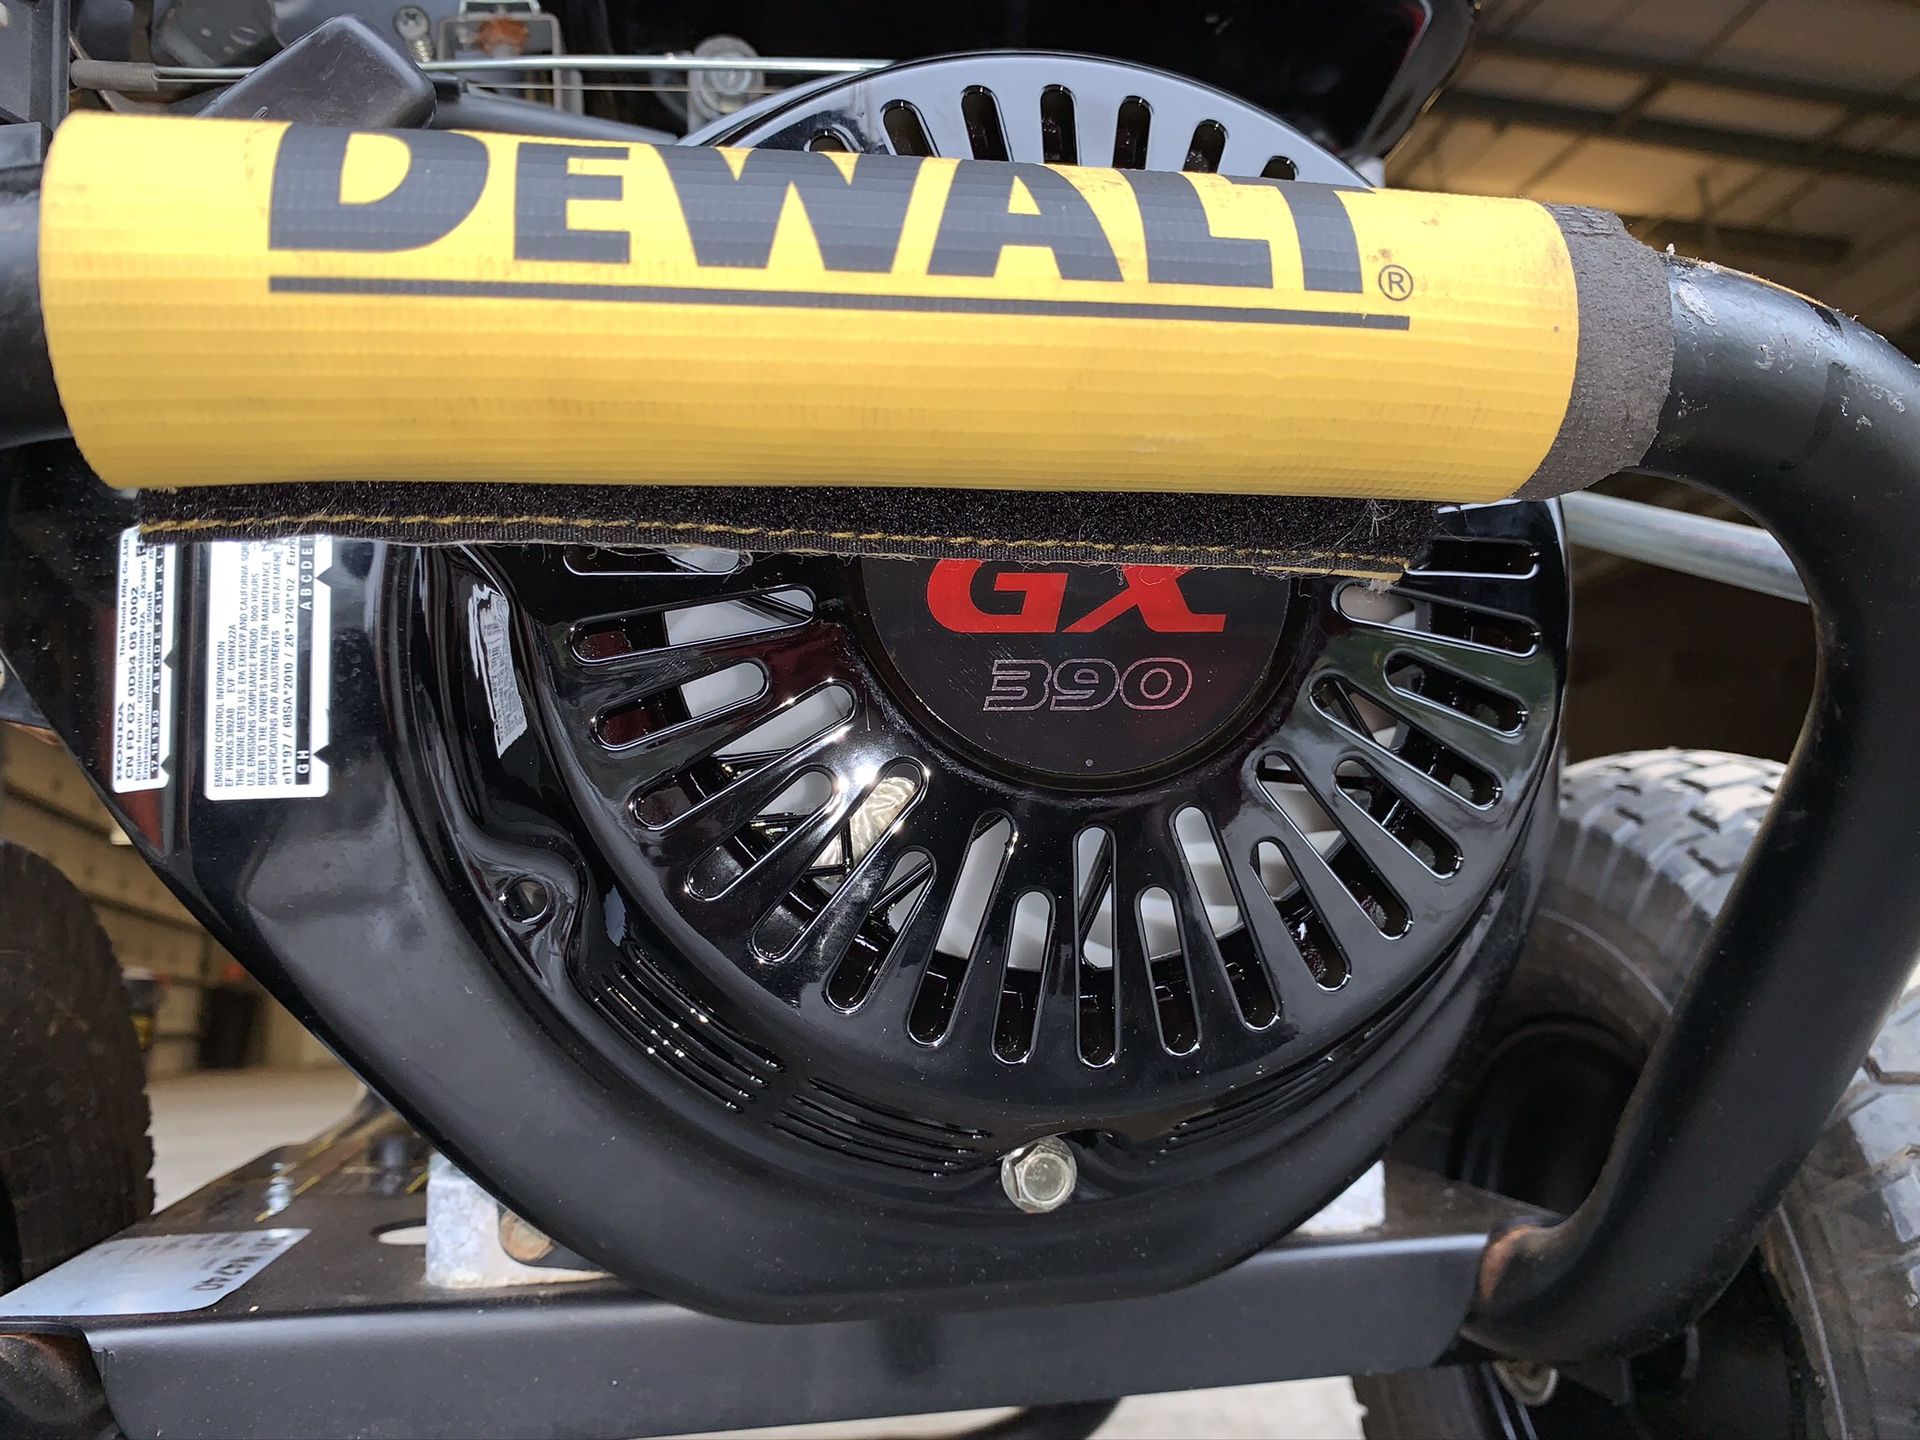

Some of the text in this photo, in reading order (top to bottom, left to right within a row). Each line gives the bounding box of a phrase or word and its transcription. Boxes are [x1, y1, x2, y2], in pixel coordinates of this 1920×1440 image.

[269, 124, 1376, 294] DEWALT
[300, 561, 312, 569] D
[240, 566, 248, 610] CALIFORNIA
[251, 573, 259, 601] HOURS
[927, 557, 1227, 633] GX
[130, 586, 138, 625] 0002
[300, 602, 311, 610] A
[239, 614, 248, 631] AND
[130, 632, 137, 649] 05
[228, 625, 236, 670] CMHNX22A
[250, 629, 258, 658] PERIOD
[258, 562, 270, 785] REFER TO THE OWNER'S MANUAL FOR MAINTENANCE
[271, 630, 279, 693] ADJUSTMENTS
[238, 670, 246, 684] EPA
[248, 662, 257, 716] COMPLIANCE
[982, 657, 1193, 711] 390
[127, 703, 135, 723] G2
[152, 710, 159, 723] 20
[214, 642, 225, 787] EMISSION CONTROL INFORMATION
[270, 697, 278, 714] AND
[237, 706, 246, 732] MEETS
[126, 730, 134, 750] FD
[152, 727, 158, 738] 19
[247, 720, 256, 766] EMISSIONS
[151, 743, 158, 755] 18
[236, 736, 245, 765] ENGINE
[269, 718, 278, 785] SPECIFICATIONS
[297, 750, 309, 759] H
[126, 756, 134, 778] CN
[151, 760, 158, 772] 17
[236, 769, 244, 786] THIS
[297, 764, 309, 773] G
